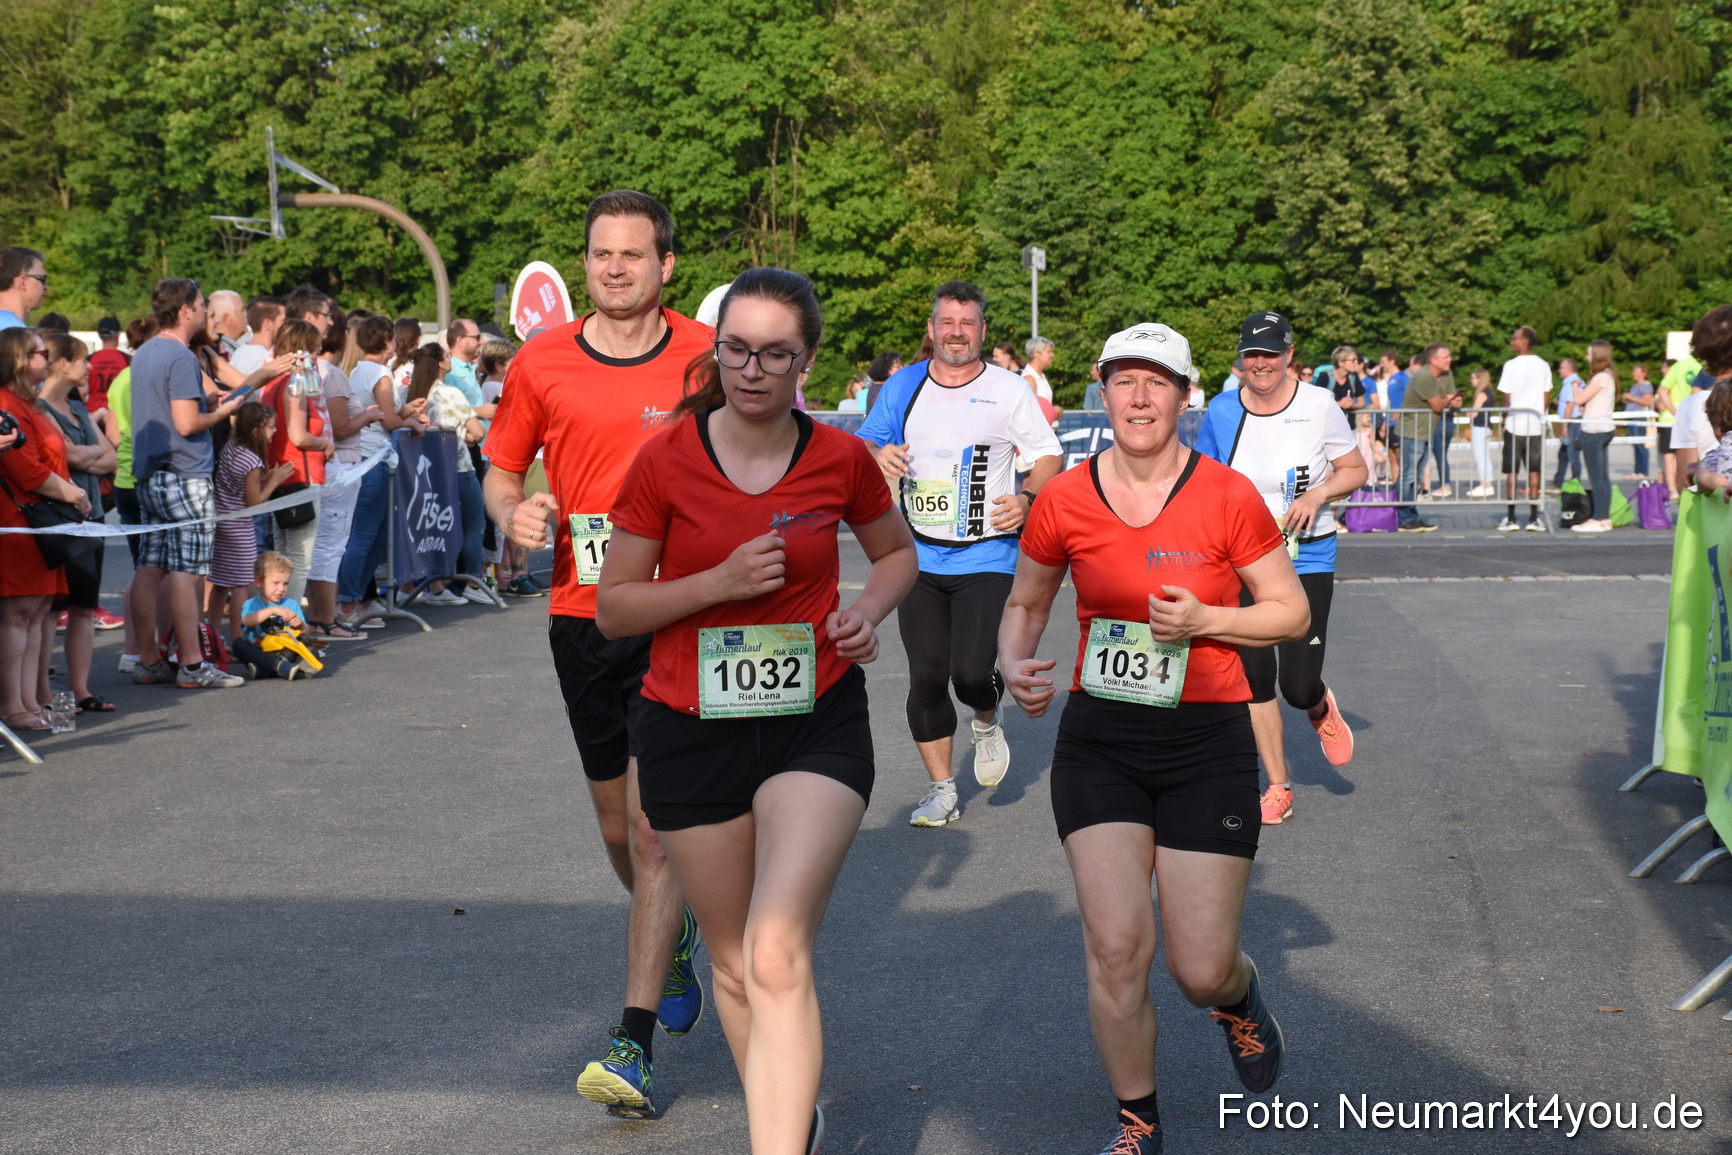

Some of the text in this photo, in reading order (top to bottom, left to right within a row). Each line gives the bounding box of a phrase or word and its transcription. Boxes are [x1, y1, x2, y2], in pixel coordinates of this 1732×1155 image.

[968, 445, 991, 536] HUBER
[910, 494, 949, 512] 1056
[958, 463, 970, 537] TECHNOLOGY
[715, 642, 763, 654] firmenlauf
[788, 647, 808, 656] 2019
[1161, 649, 1182, 658] 2019
[714, 656, 801, 691] 1032
[1096, 647, 1170, 685] 1034
[1102, 677, 1156, 692] Völkl Michaela
[738, 692, 781, 701] Riel Lena
